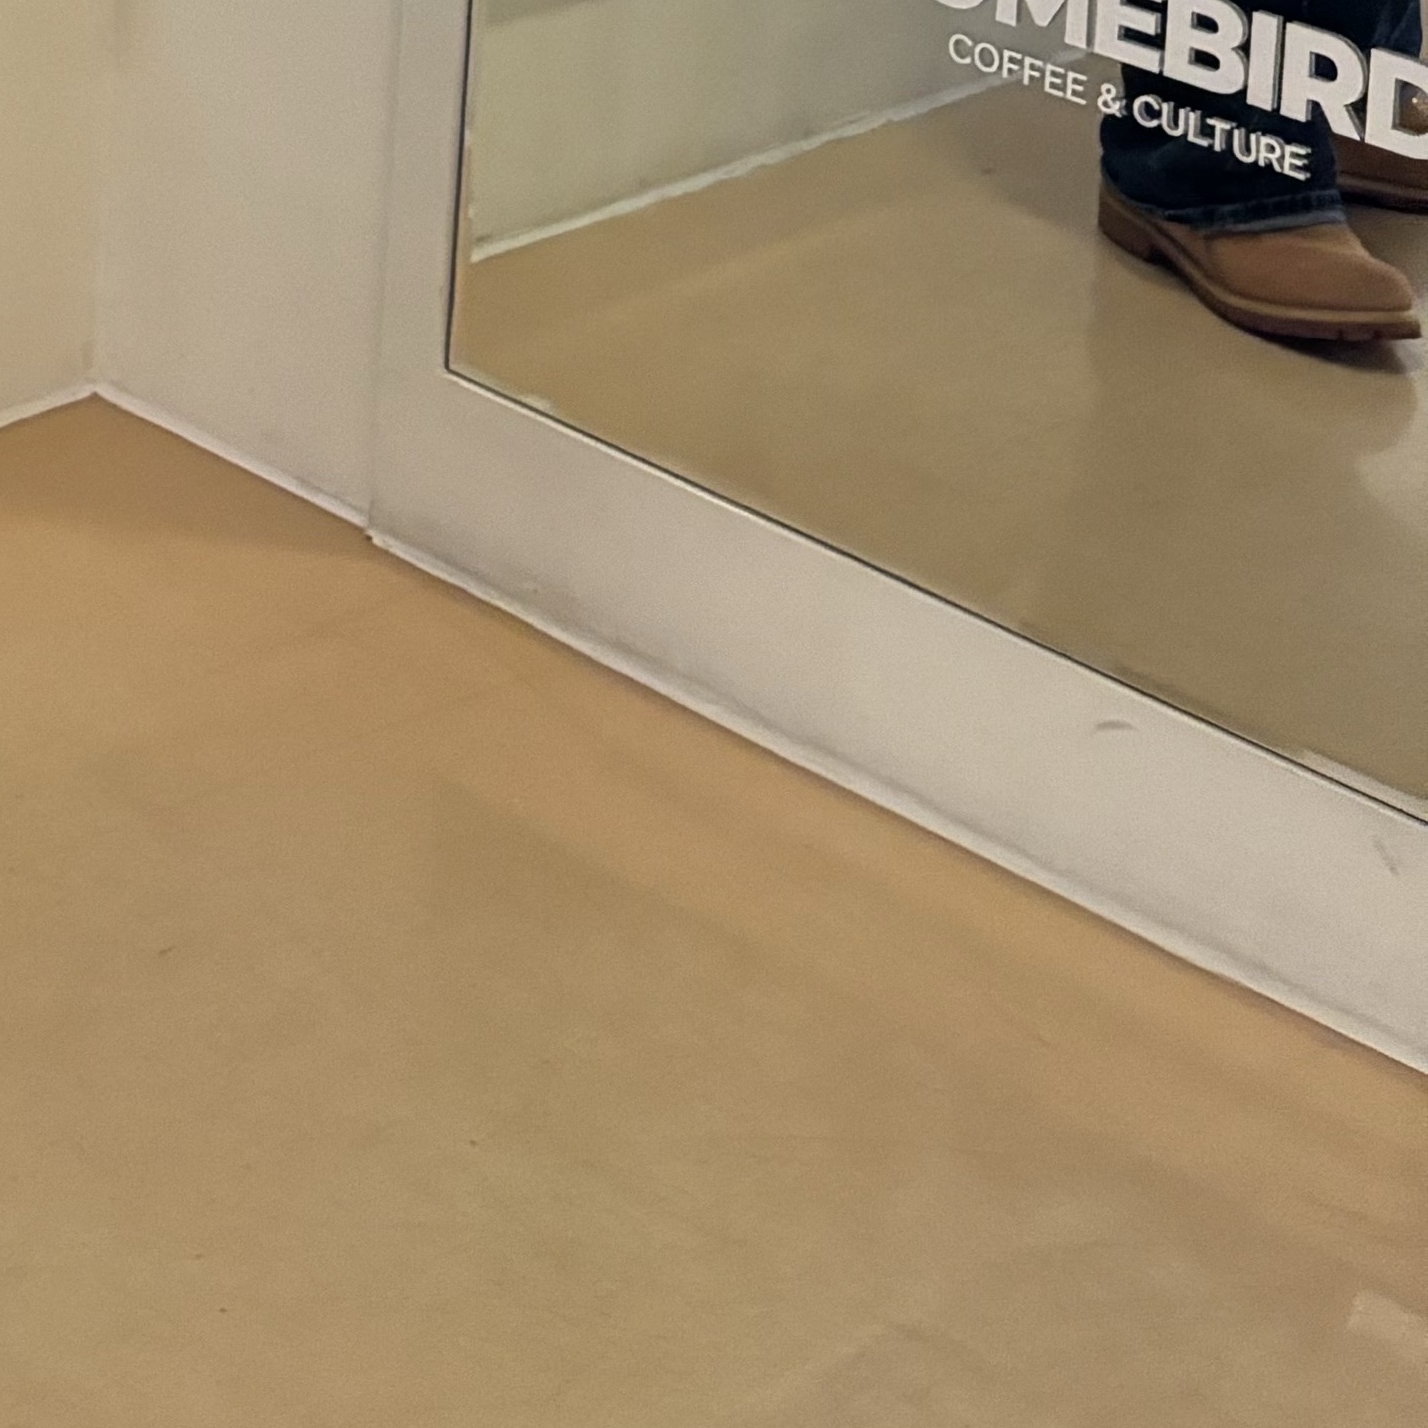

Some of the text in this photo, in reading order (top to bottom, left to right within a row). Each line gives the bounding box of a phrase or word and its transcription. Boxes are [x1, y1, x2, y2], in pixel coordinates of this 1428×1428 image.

[947, 33, 1311, 181] COFFEE & CULTURE
